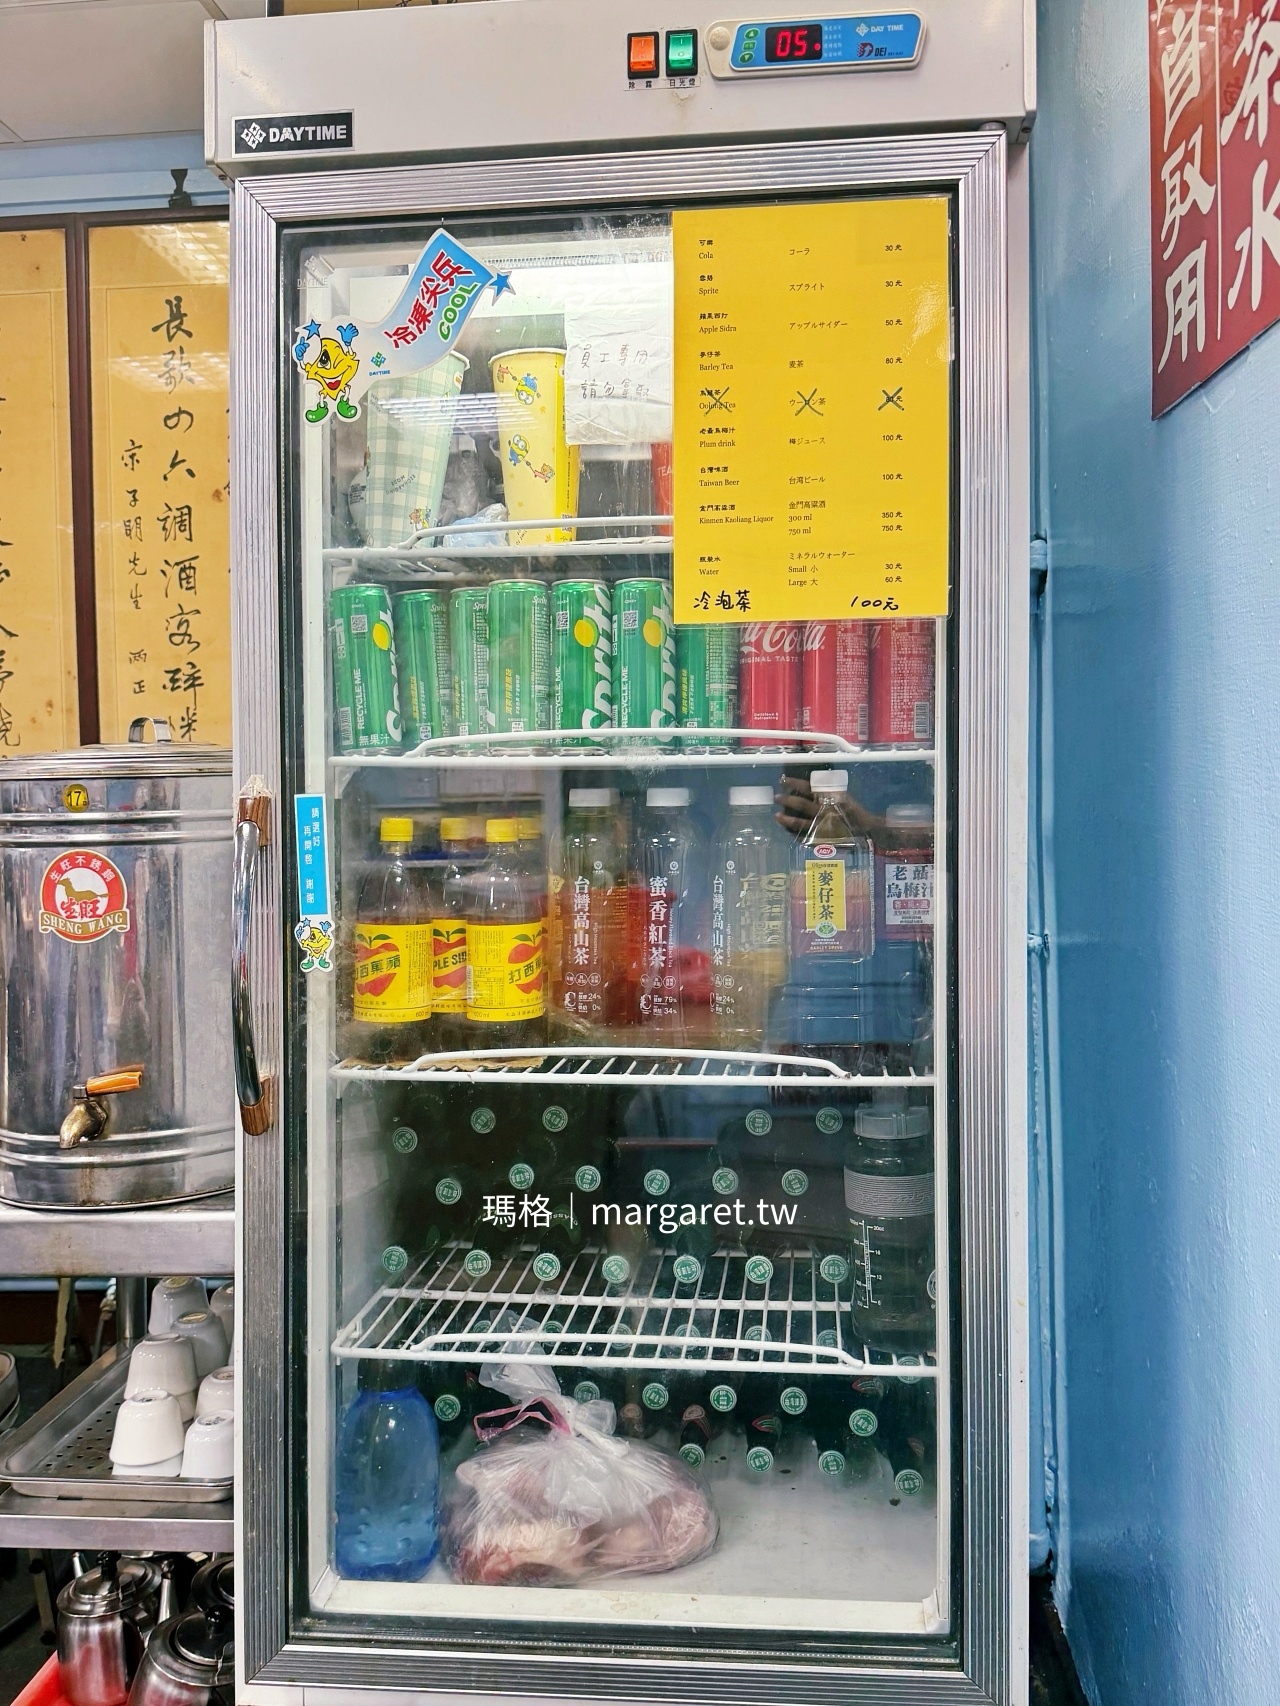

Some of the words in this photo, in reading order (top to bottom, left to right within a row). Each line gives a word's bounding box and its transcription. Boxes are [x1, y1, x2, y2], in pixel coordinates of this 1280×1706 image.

[268, 124, 347, 142] DAYTIME
[789, 248, 810, 256] コーラ
[698, 287, 719, 296] Sprite
[789, 283, 825, 291] スプライト
[439, 282, 478, 341] COOL
[699, 326, 718, 334] Apple
[789, 360, 804, 368] 麦茶
[789, 437, 826, 446] 梅ジュース
[789, 476, 826, 485] 台湾ビール
[693, 590, 751, 612] 冷泡茶
[850, 596, 900, 611] 100元
[354, 668, 362, 684] ME
[622, 666, 628, 681] ME
[356, 686, 364, 730] RECYCLE
[358, 734, 390, 746] 無果汁
[312, 808, 320, 846] 請選好
[818, 870, 834, 920] 麥仔茶
[43, 914, 82, 934] SHENG
[88, 912, 123, 932] WANG
[573, 876, 590, 966] 台灣高山茶
[648, 876, 668, 968] 蜜香紅茶
[713, 875, 724, 966] 台灣高山茶
